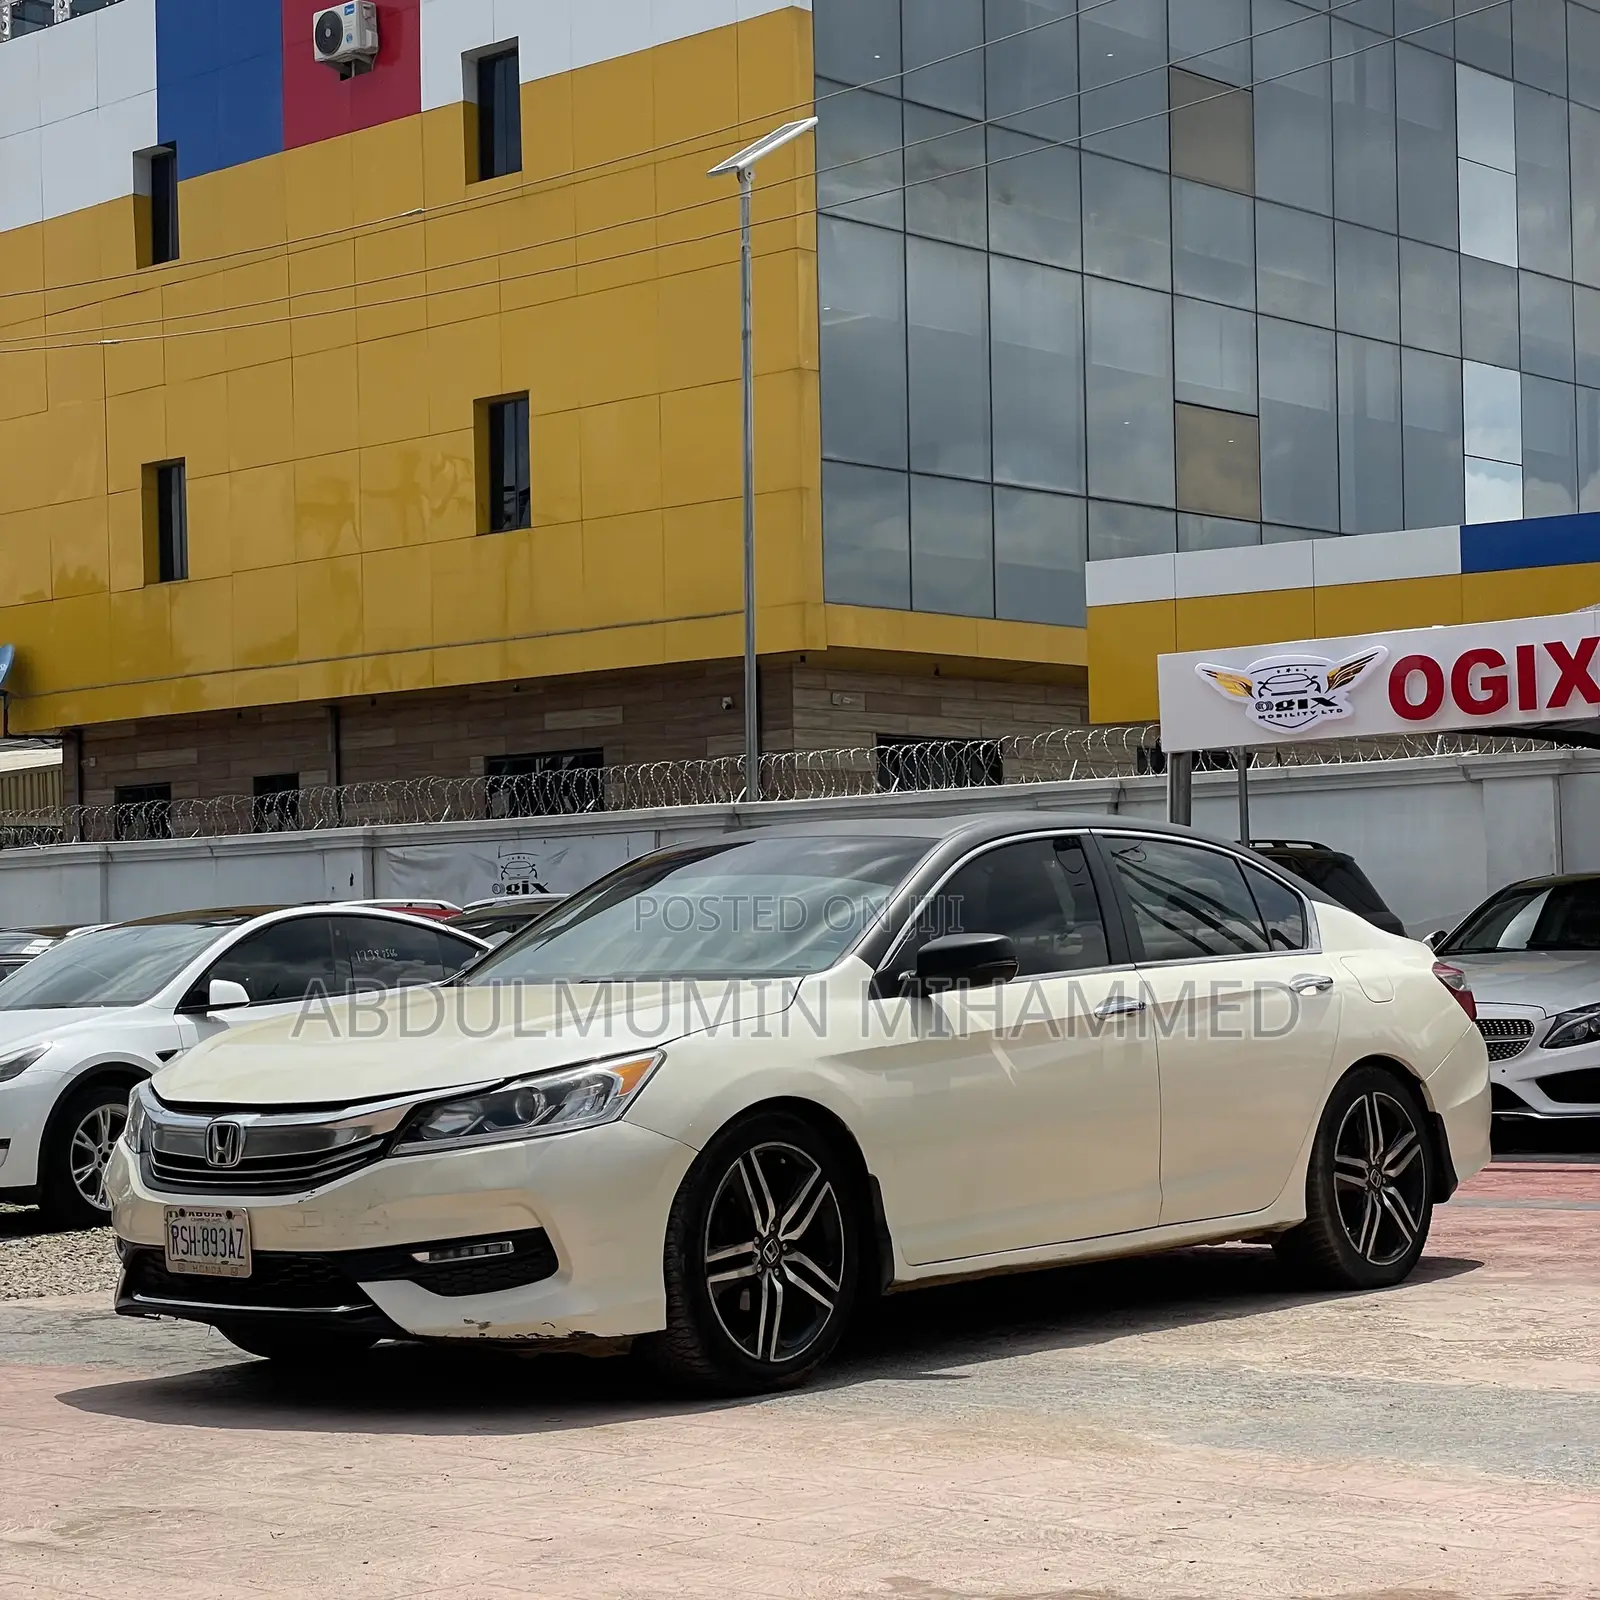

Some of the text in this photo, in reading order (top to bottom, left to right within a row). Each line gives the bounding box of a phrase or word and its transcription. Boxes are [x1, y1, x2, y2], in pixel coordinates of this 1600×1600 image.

[1388, 636, 1600, 721] OGIX
[1258, 711, 1317, 719] MOBILITY
[171, 1225, 245, 1259] RSH-893AZ
